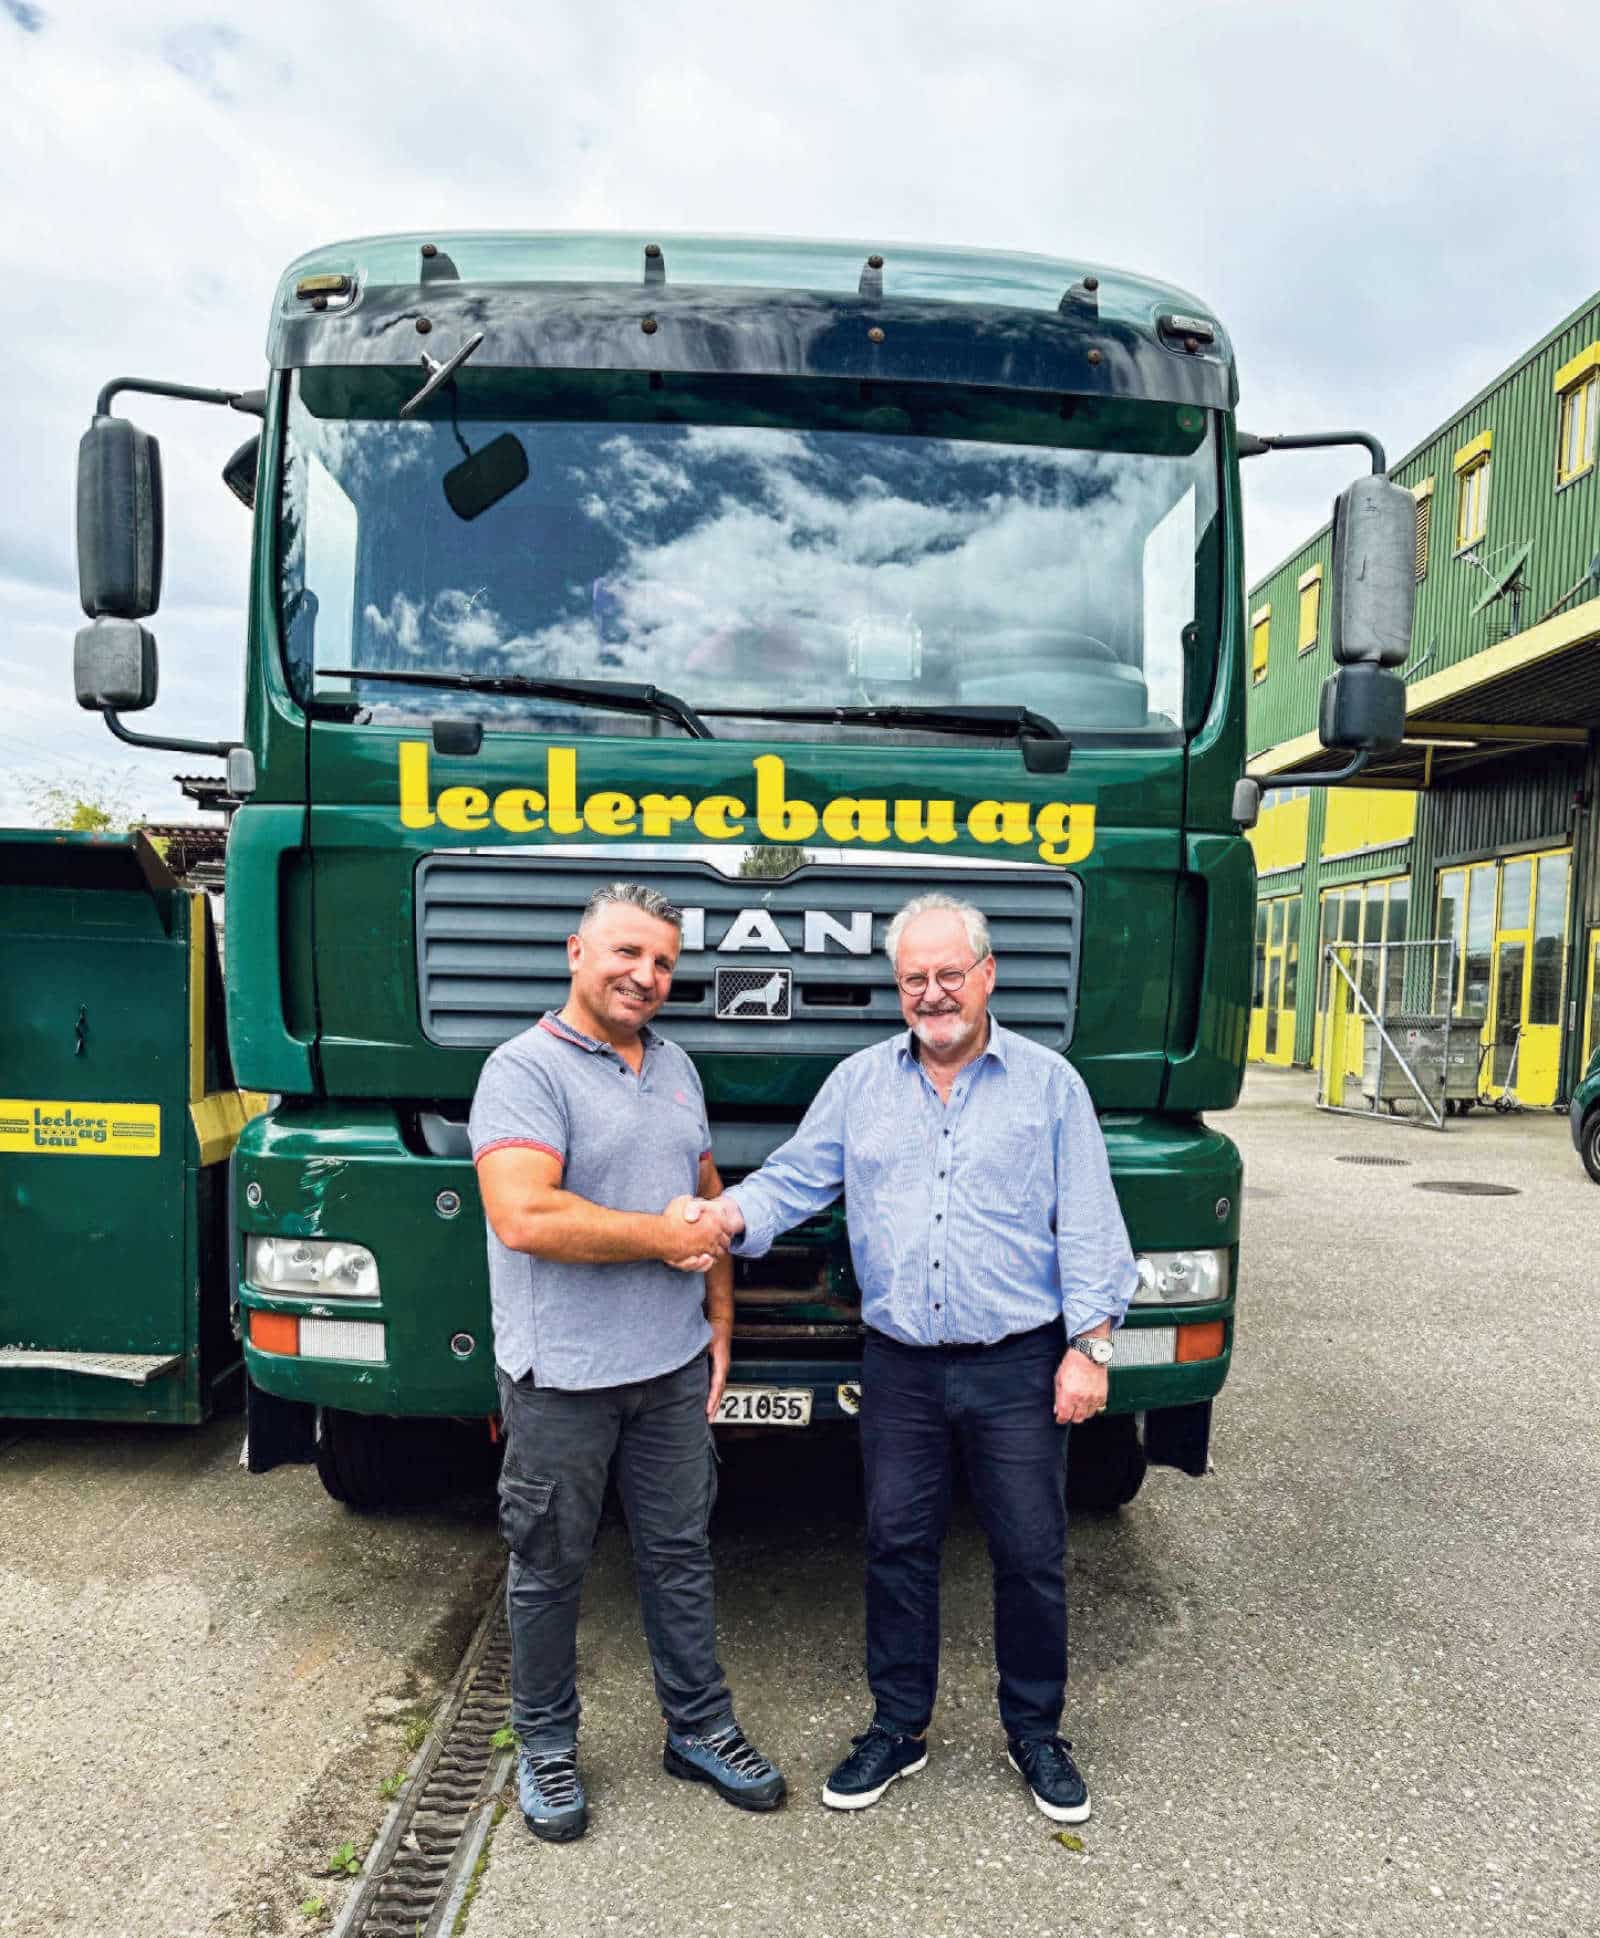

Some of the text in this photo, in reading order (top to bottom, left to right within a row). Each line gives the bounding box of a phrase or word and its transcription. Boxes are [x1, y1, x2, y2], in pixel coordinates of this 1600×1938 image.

[681, 907, 872, 954] AN
[34, 1108, 107, 1126] leclerc
[34, 1128, 107, 1146] bau ag
